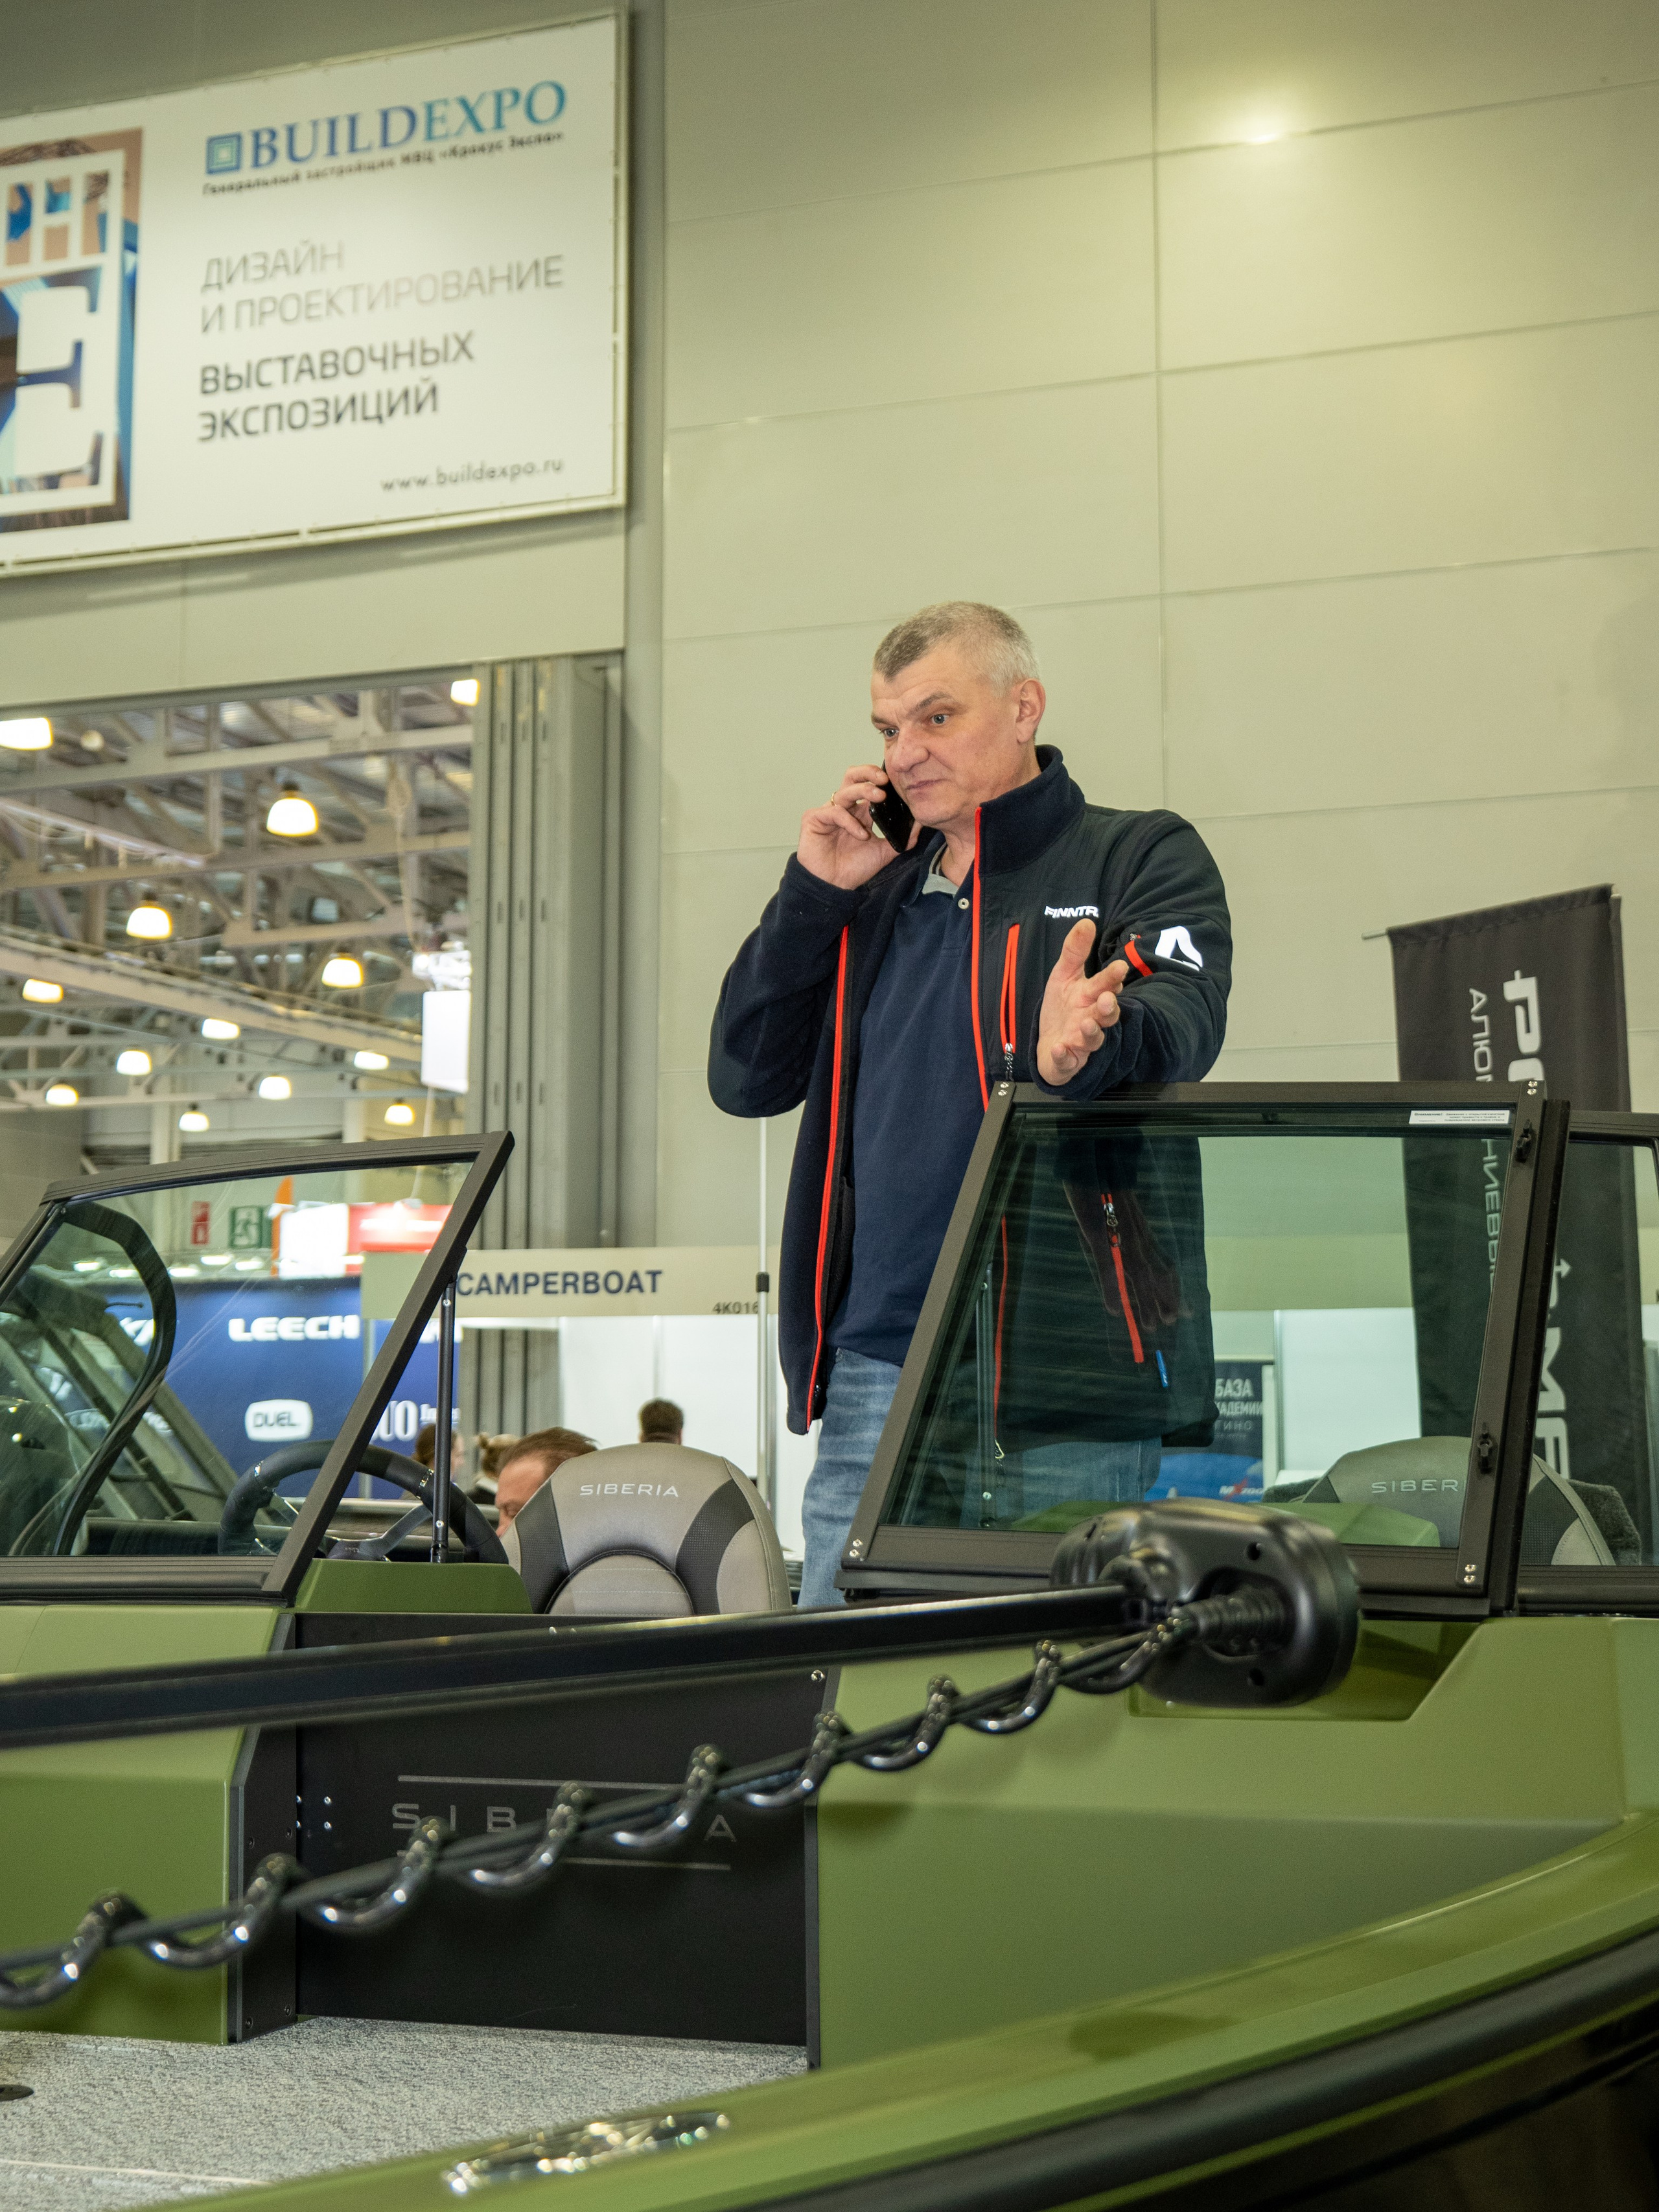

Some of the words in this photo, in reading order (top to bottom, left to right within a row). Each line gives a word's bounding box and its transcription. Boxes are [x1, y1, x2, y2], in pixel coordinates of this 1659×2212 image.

[249, 80, 568, 170] BUILDEXPO
[202, 240, 345, 294] ДИЗАЙН
[201, 305, 226, 334] И
[234, 255, 564, 330] ПРОЕКТИРОВАНИЕ
[200, 330, 476, 395] ВЫСТАВОЧНЫХ
[198, 378, 439, 443] ЭКСПОЗИЦИЙ
[380, 456, 564, 494] www.buildexpo.ru
[1044, 905, 1099, 918] FINNTR
[457, 1269, 664, 1296] CAMPERBOAT
[228, 1314, 360, 1342] LEECH
[1215, 1378, 1254, 1397] БАЗА
[254, 1411, 300, 1428] DUEL
[579, 1482, 679, 1498] SIBERIA
[391, 1802, 737, 1843] SIBA
